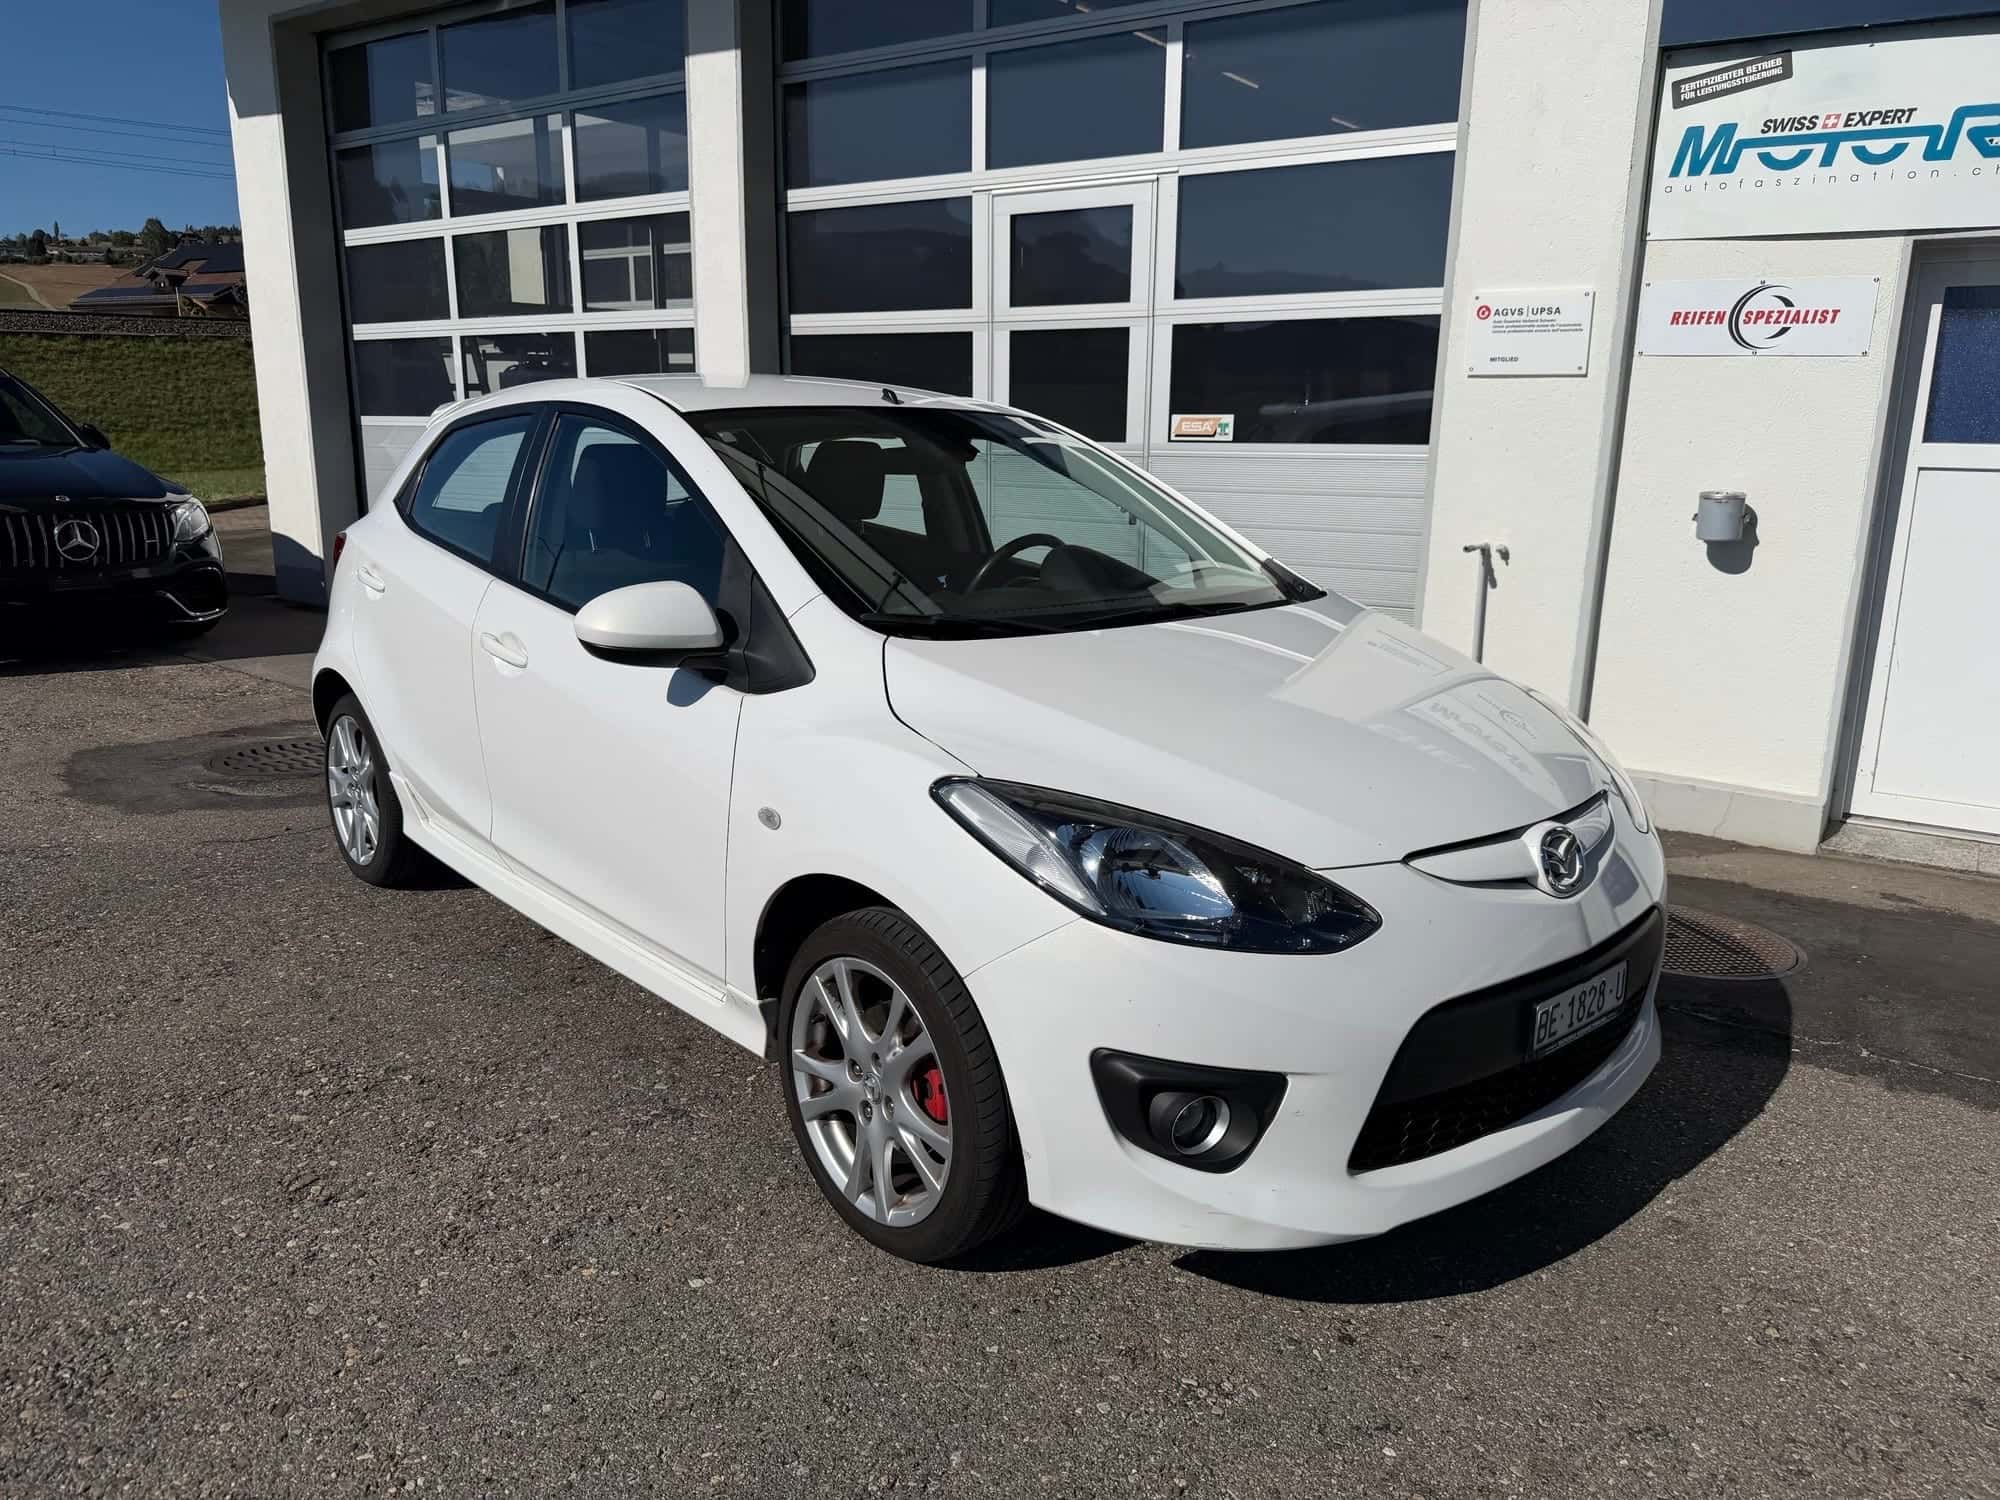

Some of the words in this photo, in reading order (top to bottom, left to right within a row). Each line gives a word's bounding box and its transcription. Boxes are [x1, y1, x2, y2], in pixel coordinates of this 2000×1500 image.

[1680, 67, 1744, 93] ZERTIFIZIERTER
[1746, 57, 1782, 75] BETRIEB
[1680, 91, 1696, 101] FÜR
[1697, 66, 1783, 97] LEISTUNGSSTEIGERUNG
[1760, 115, 1819, 134] SWISS
[1843, 107, 1918, 128] EXPERT
[1494, 307, 1524, 317] AGVS
[1531, 306, 1561, 316] UPSA
[1670, 310, 1727, 326] REIFEN
[1743, 309, 1841, 325] SPEZIALIST
[1567, 980, 1606, 1029] 1828
